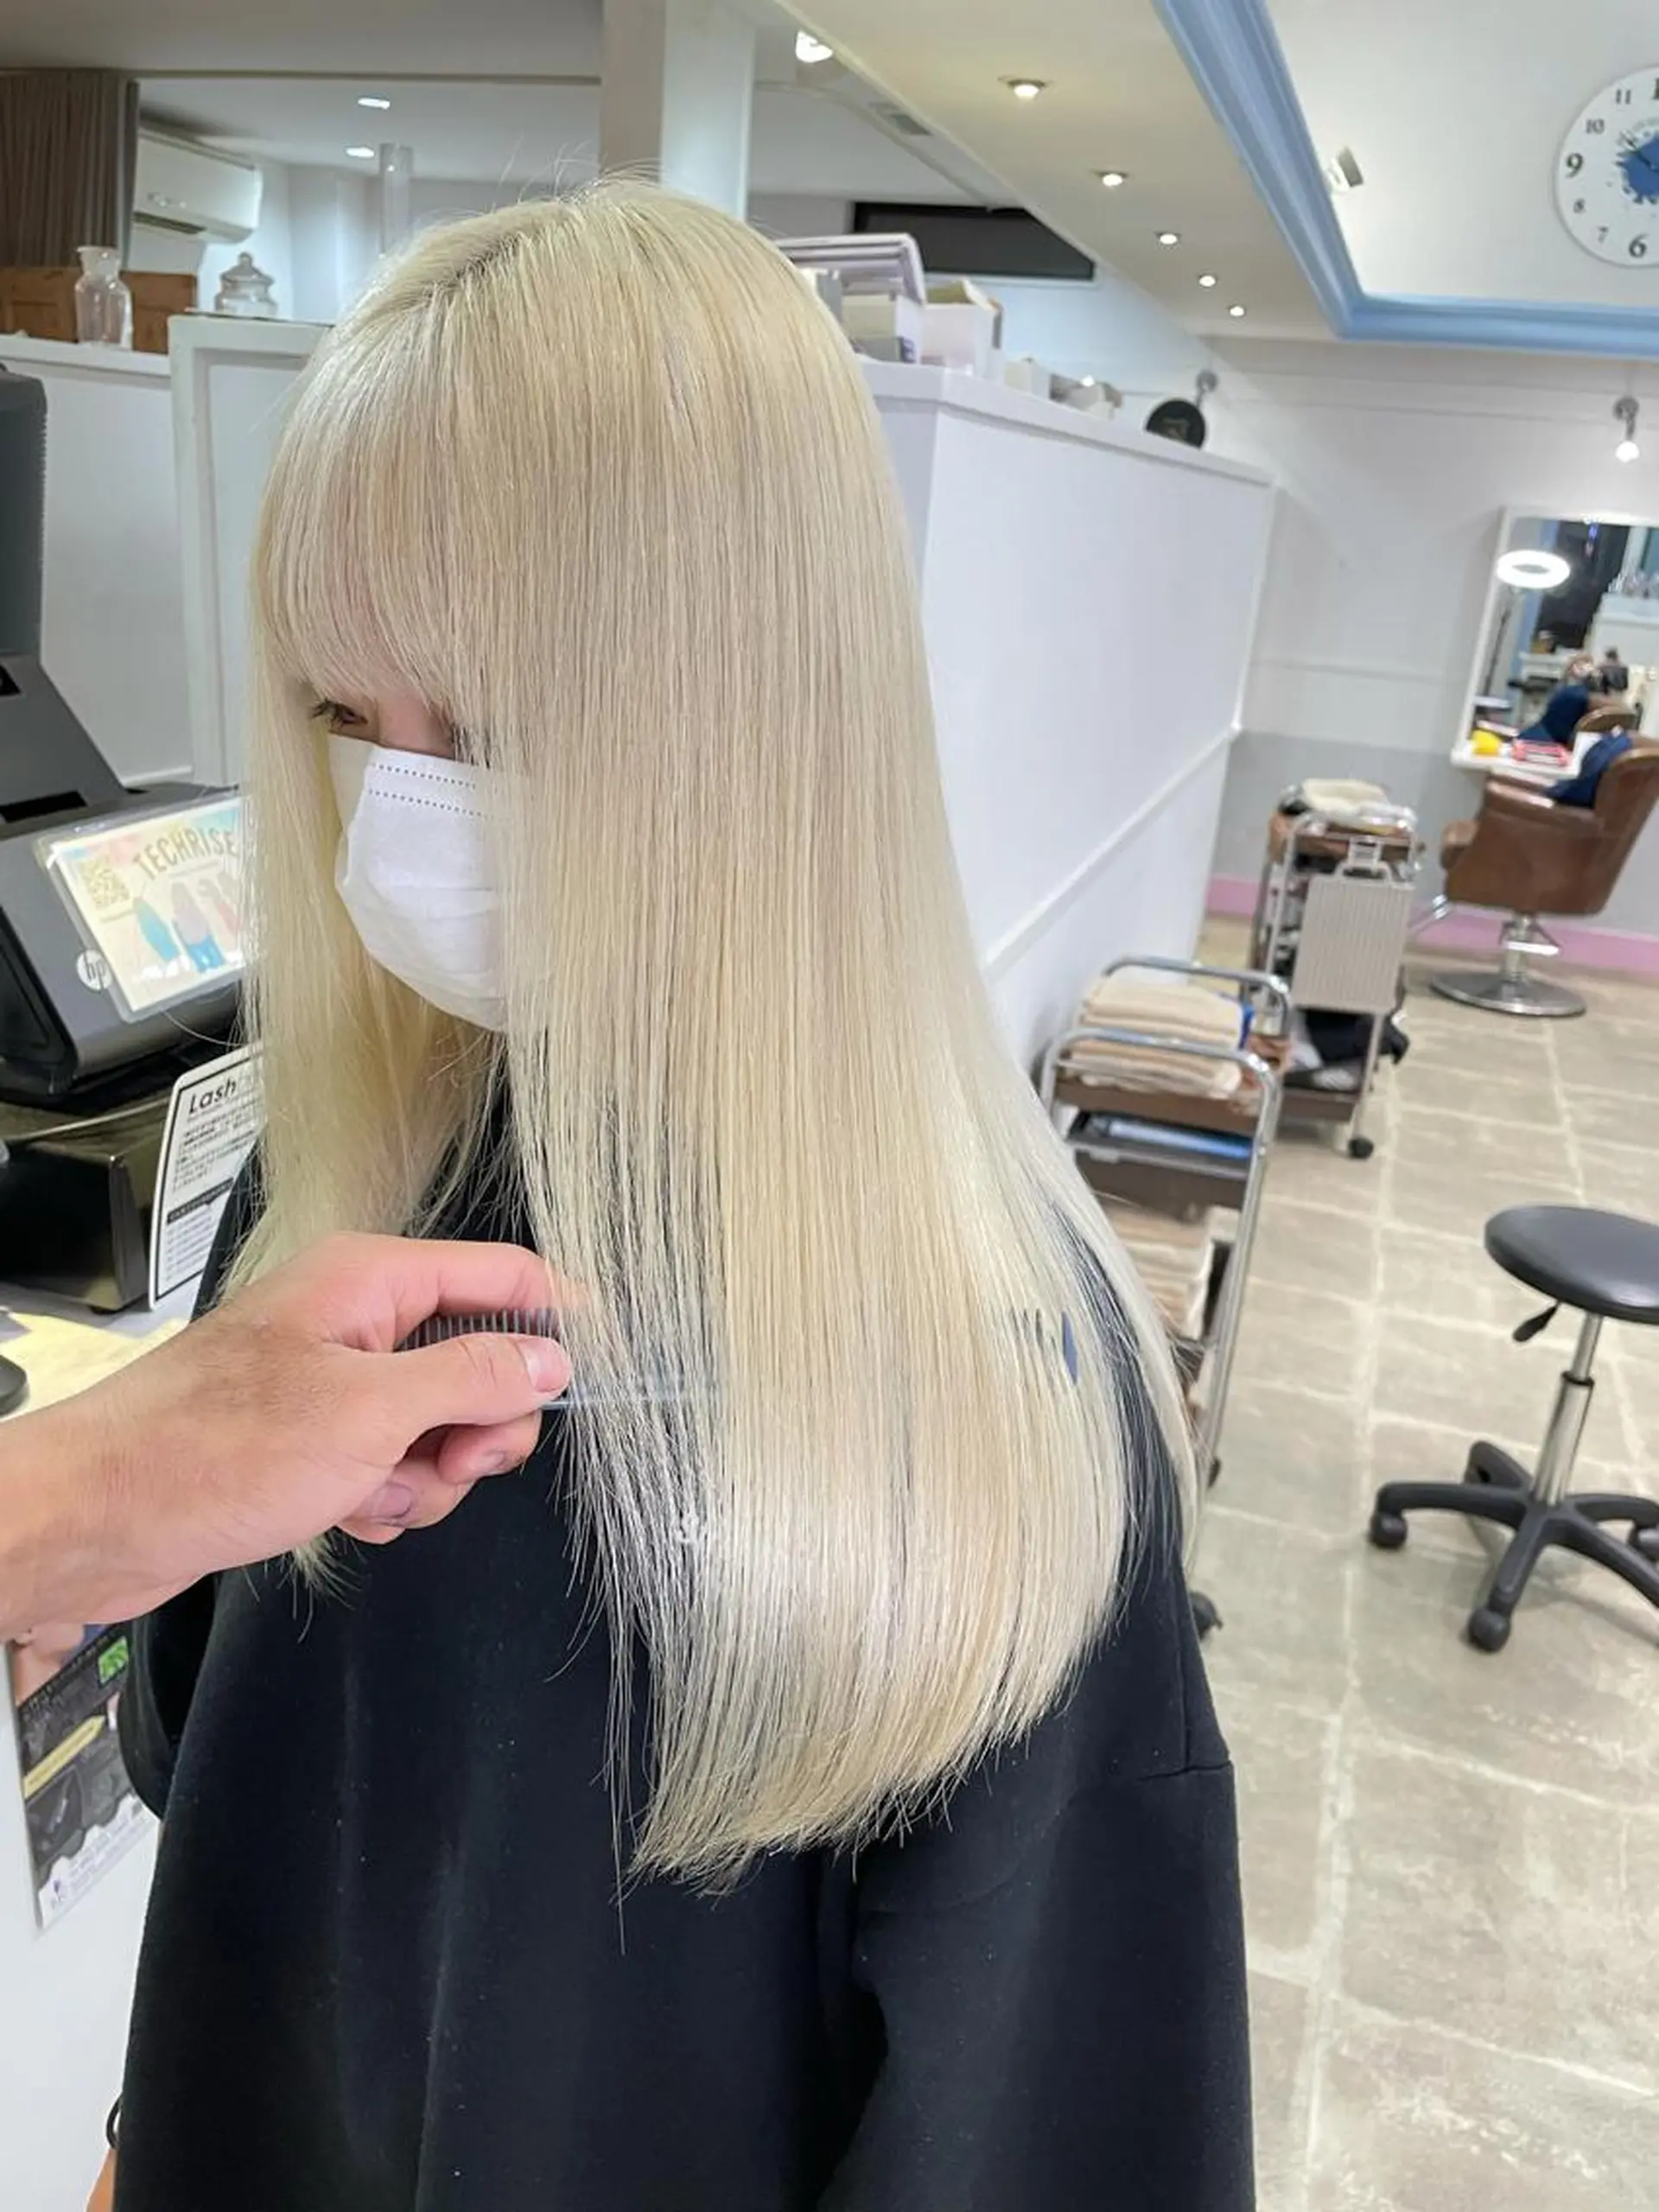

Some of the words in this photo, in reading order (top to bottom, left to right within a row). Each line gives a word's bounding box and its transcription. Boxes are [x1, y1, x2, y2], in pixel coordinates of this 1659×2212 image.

[1615, 88, 1631, 105] 11
[1585, 118, 1605, 135] 10
[1565, 152, 1584, 179] 9
[1628, 232, 1649, 259] 6
[189, 1077, 237, 1115] Lash
